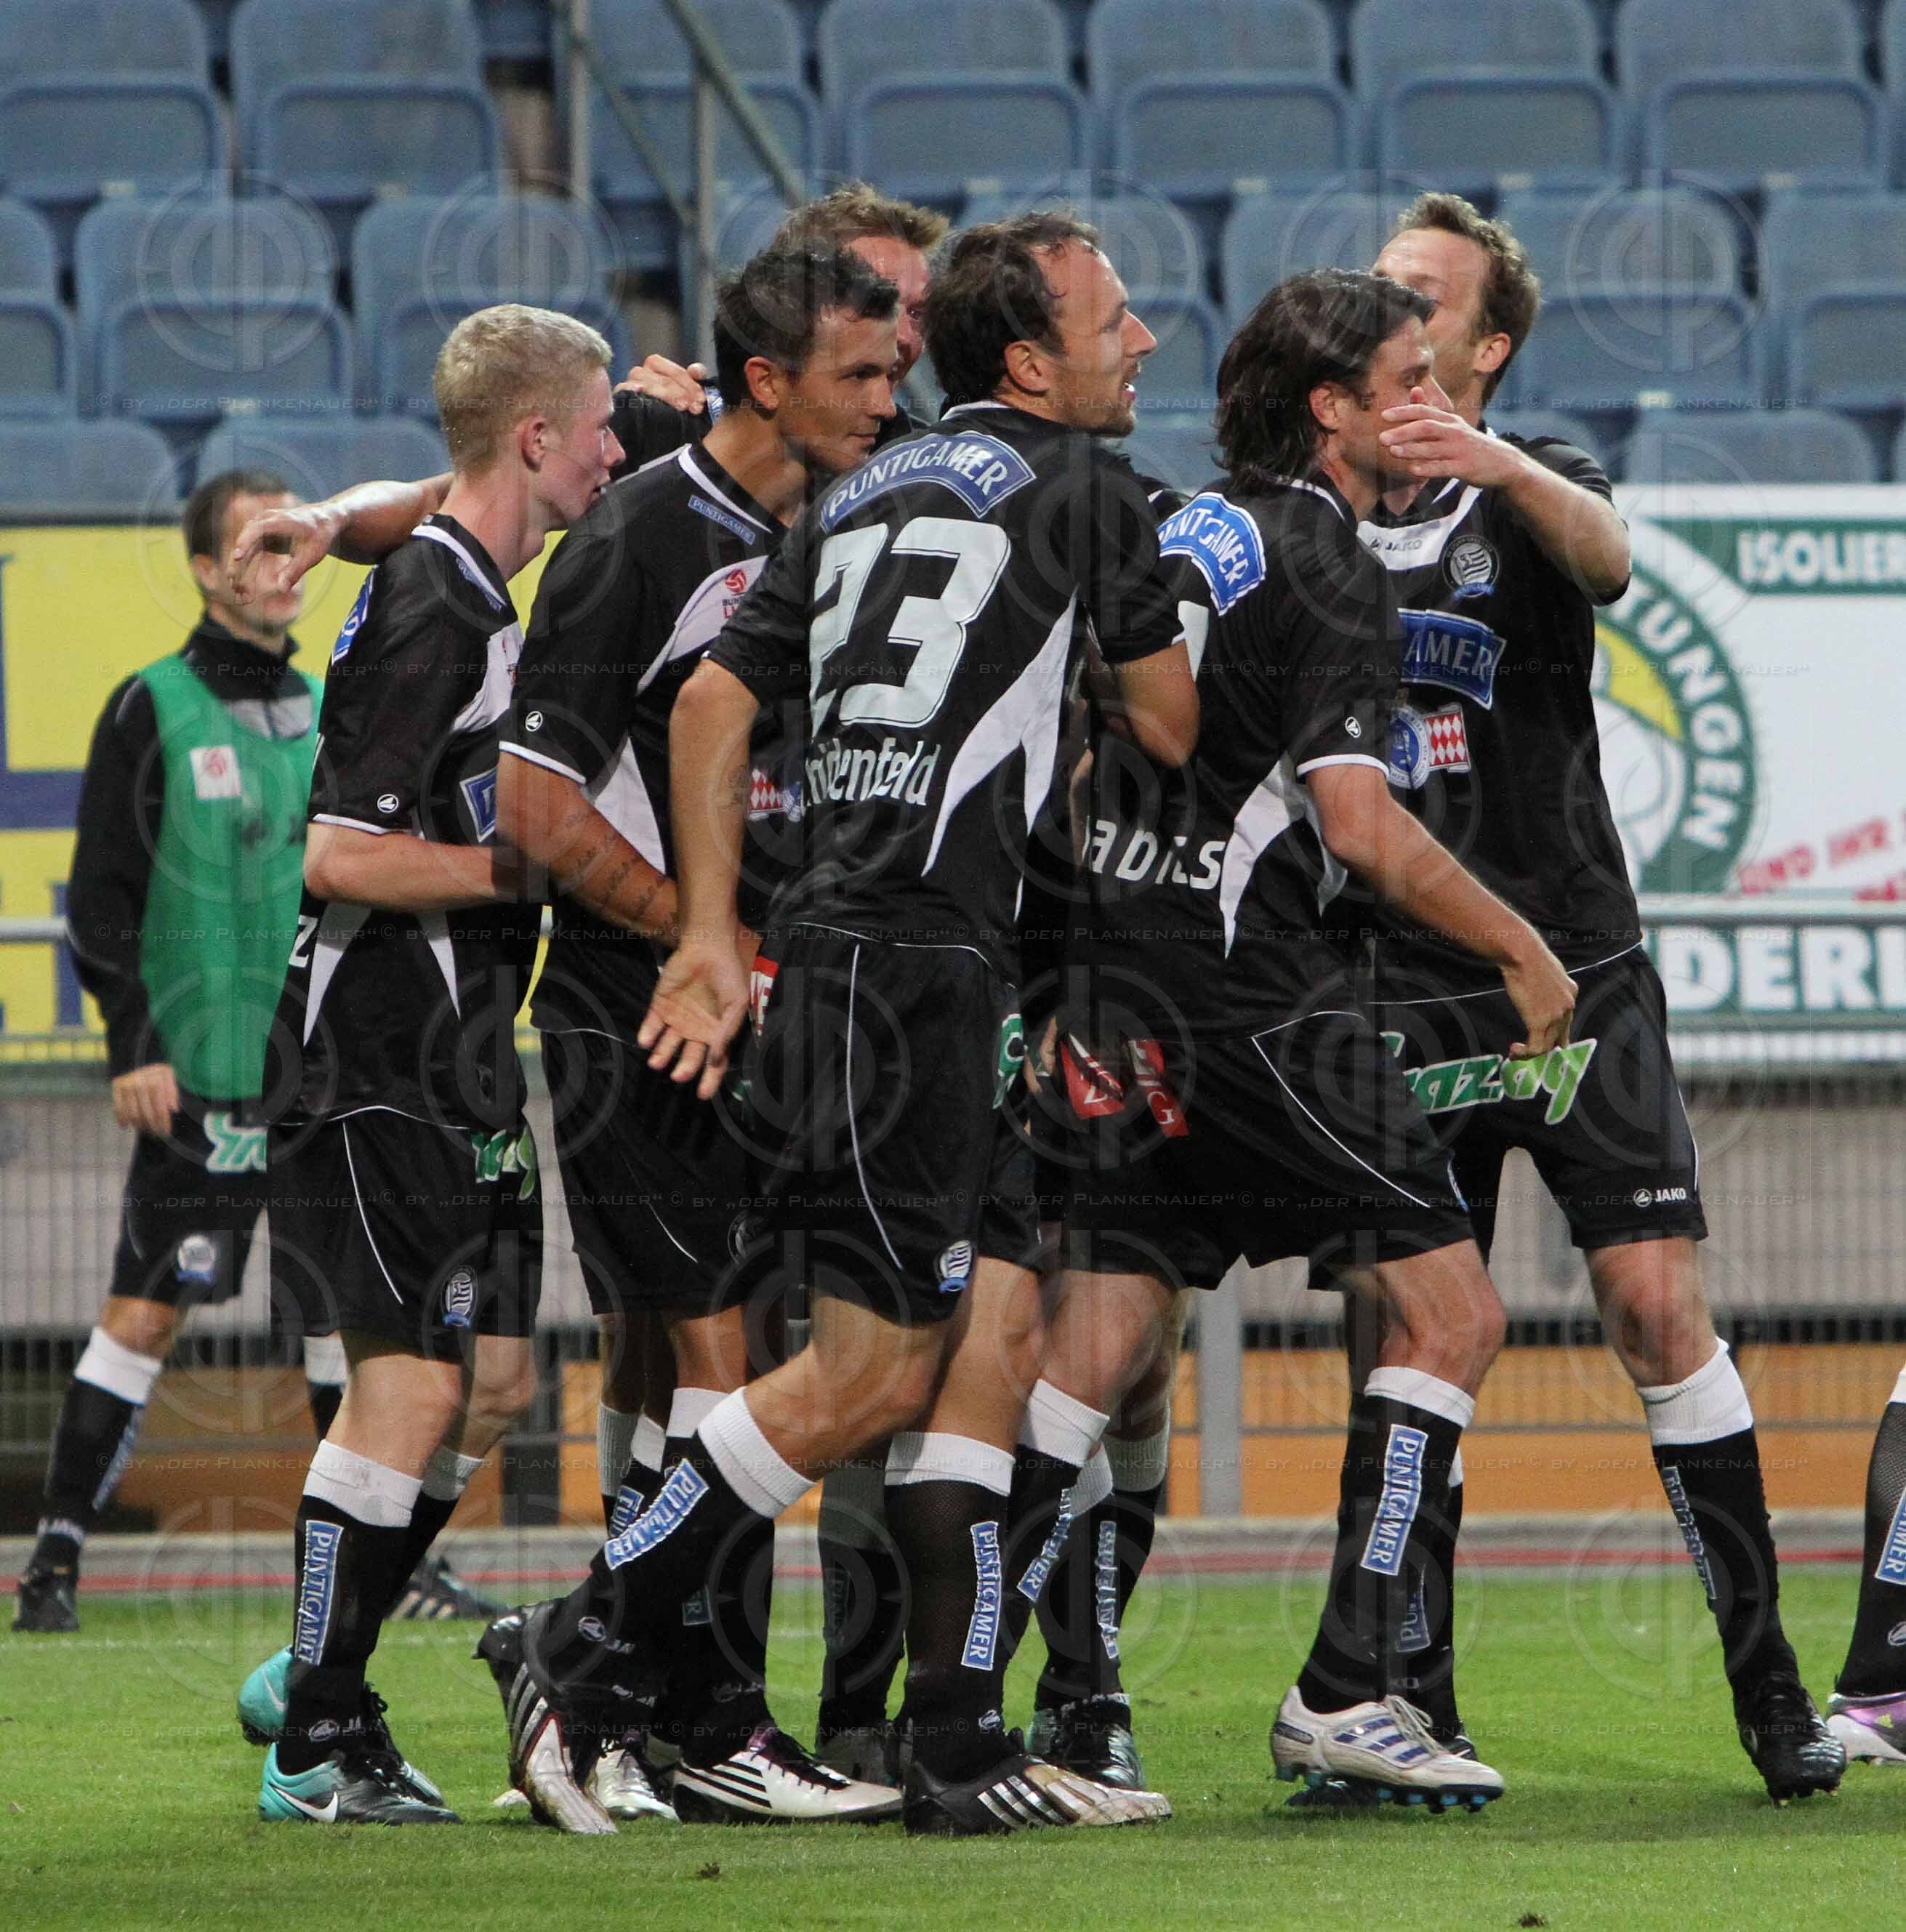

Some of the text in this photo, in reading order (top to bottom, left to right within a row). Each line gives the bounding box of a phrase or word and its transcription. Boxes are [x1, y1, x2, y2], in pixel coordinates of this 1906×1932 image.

[827, 441, 1009, 518] PUNTIGAMER
[808, 517, 1012, 737] 23
[1654, 1188, 1686, 1204] JAKO
[1370, 1433, 1420, 1566] PUNTIGAMER
